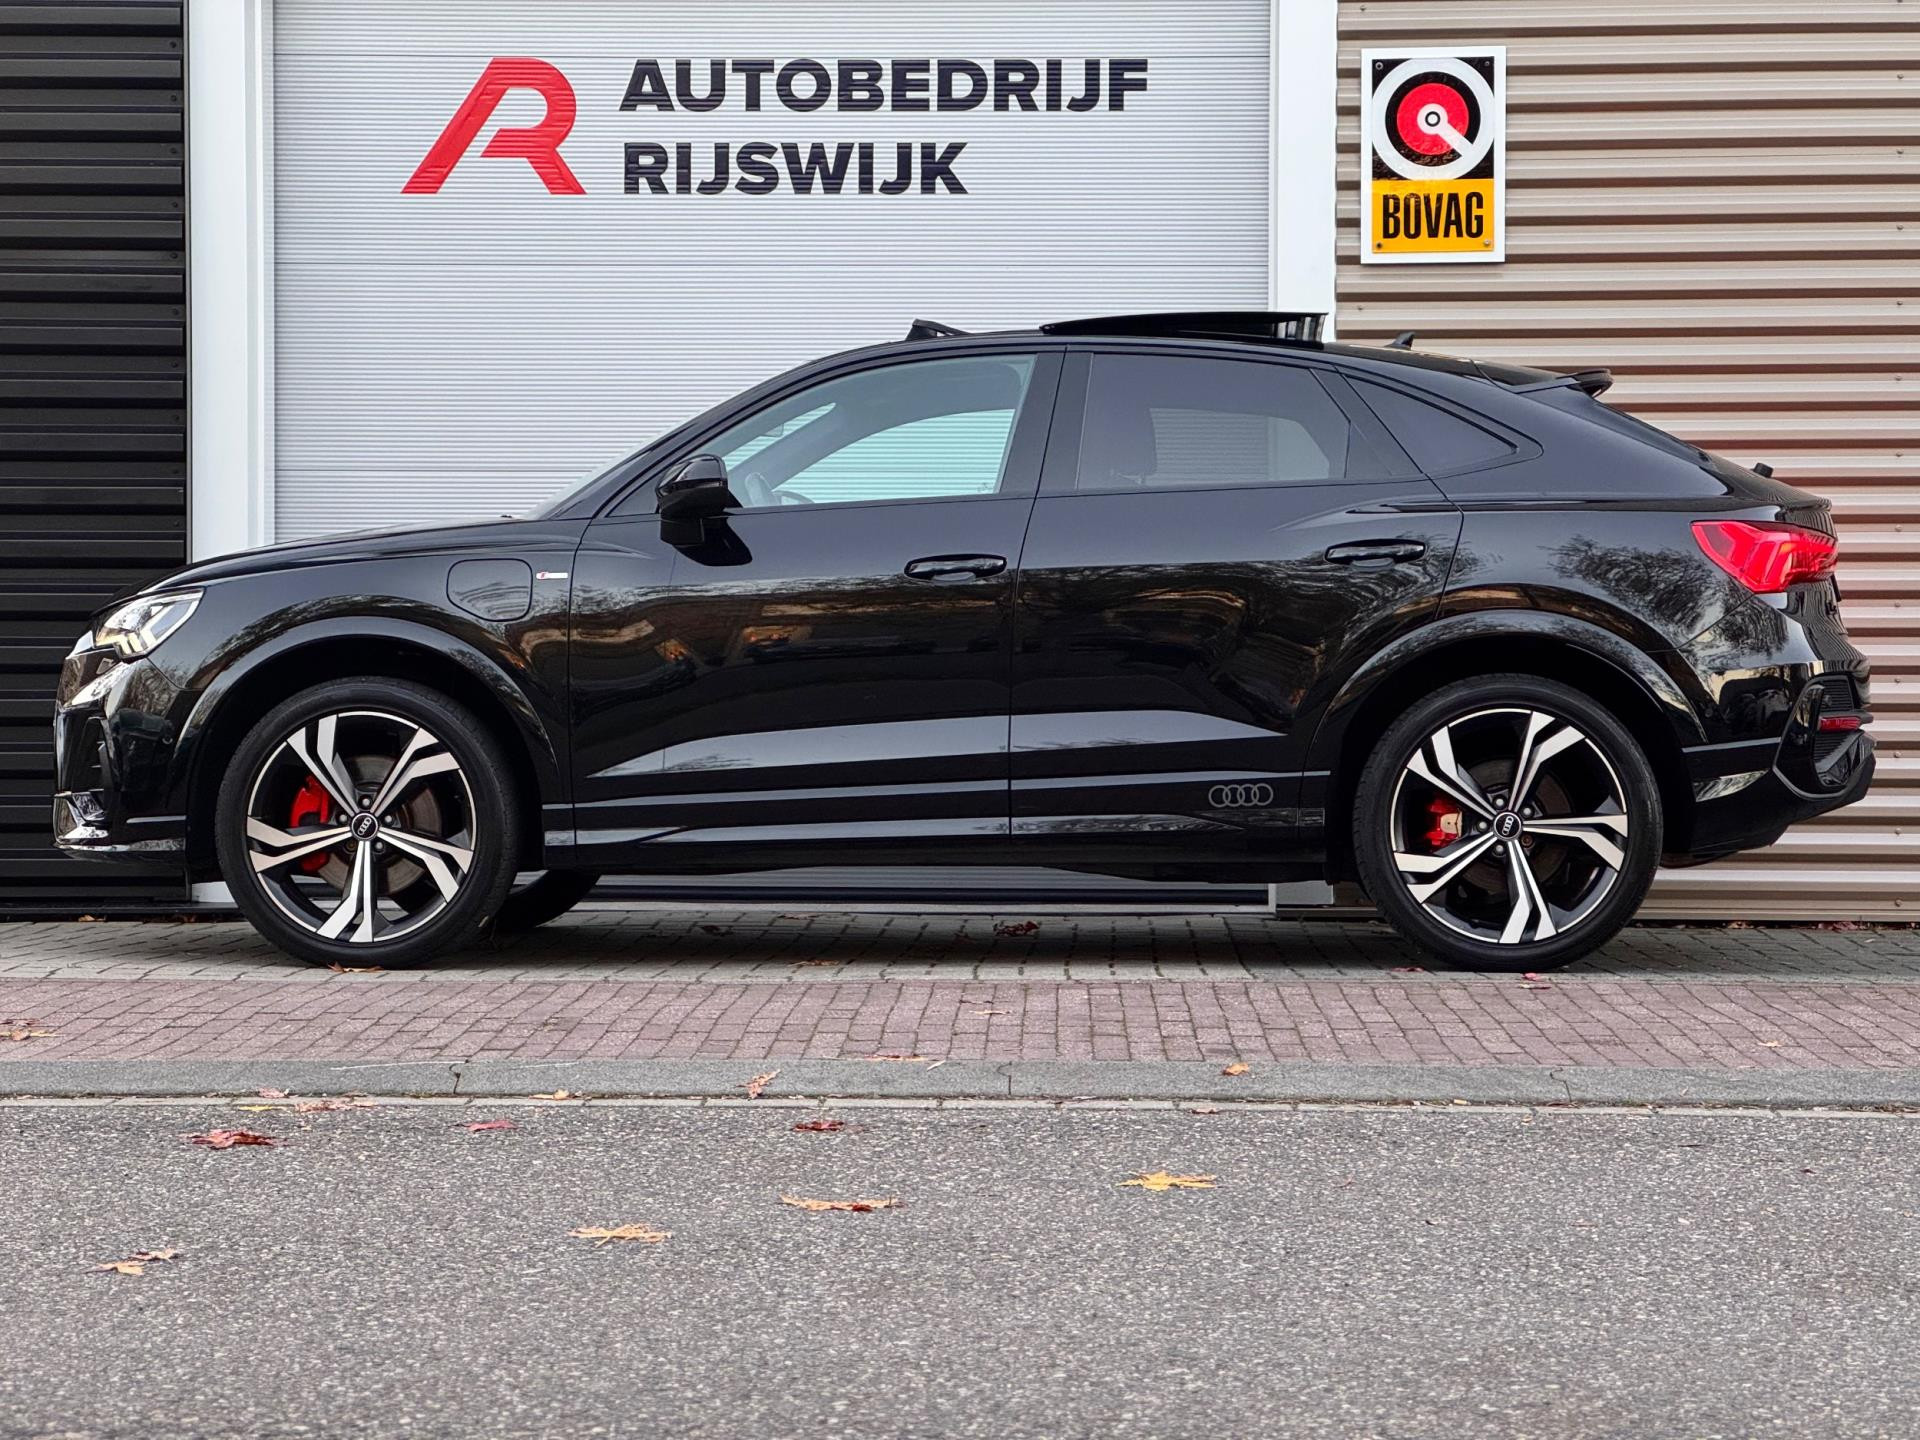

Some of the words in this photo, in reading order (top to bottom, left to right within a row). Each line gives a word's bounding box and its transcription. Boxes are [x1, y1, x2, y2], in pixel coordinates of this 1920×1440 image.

[619, 58, 1148, 113] AUTOBEDRIJF
[623, 142, 969, 195] RIJSWIJK
[1382, 191, 1484, 240] BOVAG
